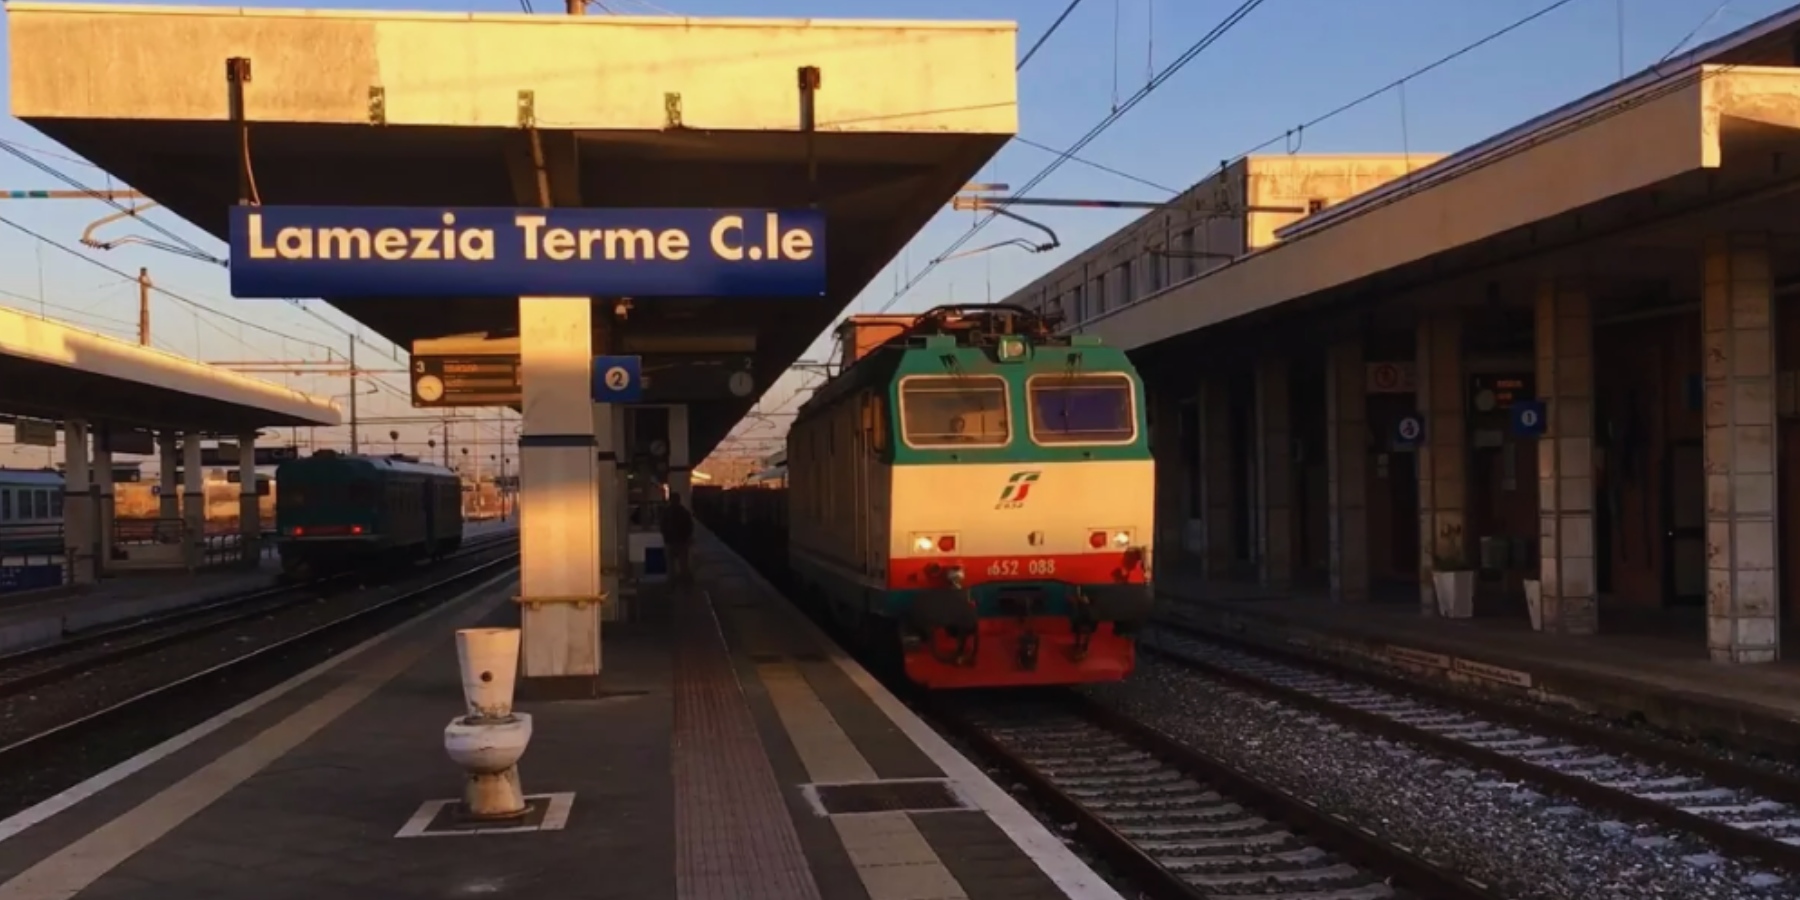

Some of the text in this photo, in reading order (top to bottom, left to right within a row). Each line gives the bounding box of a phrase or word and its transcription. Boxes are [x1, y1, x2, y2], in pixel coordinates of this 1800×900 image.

[248, 212, 814, 261] Lamezia Terme C.le
[415, 360, 426, 373] 3
[611, 371, 624, 387] 2
[1028, 558, 1055, 575] 088
